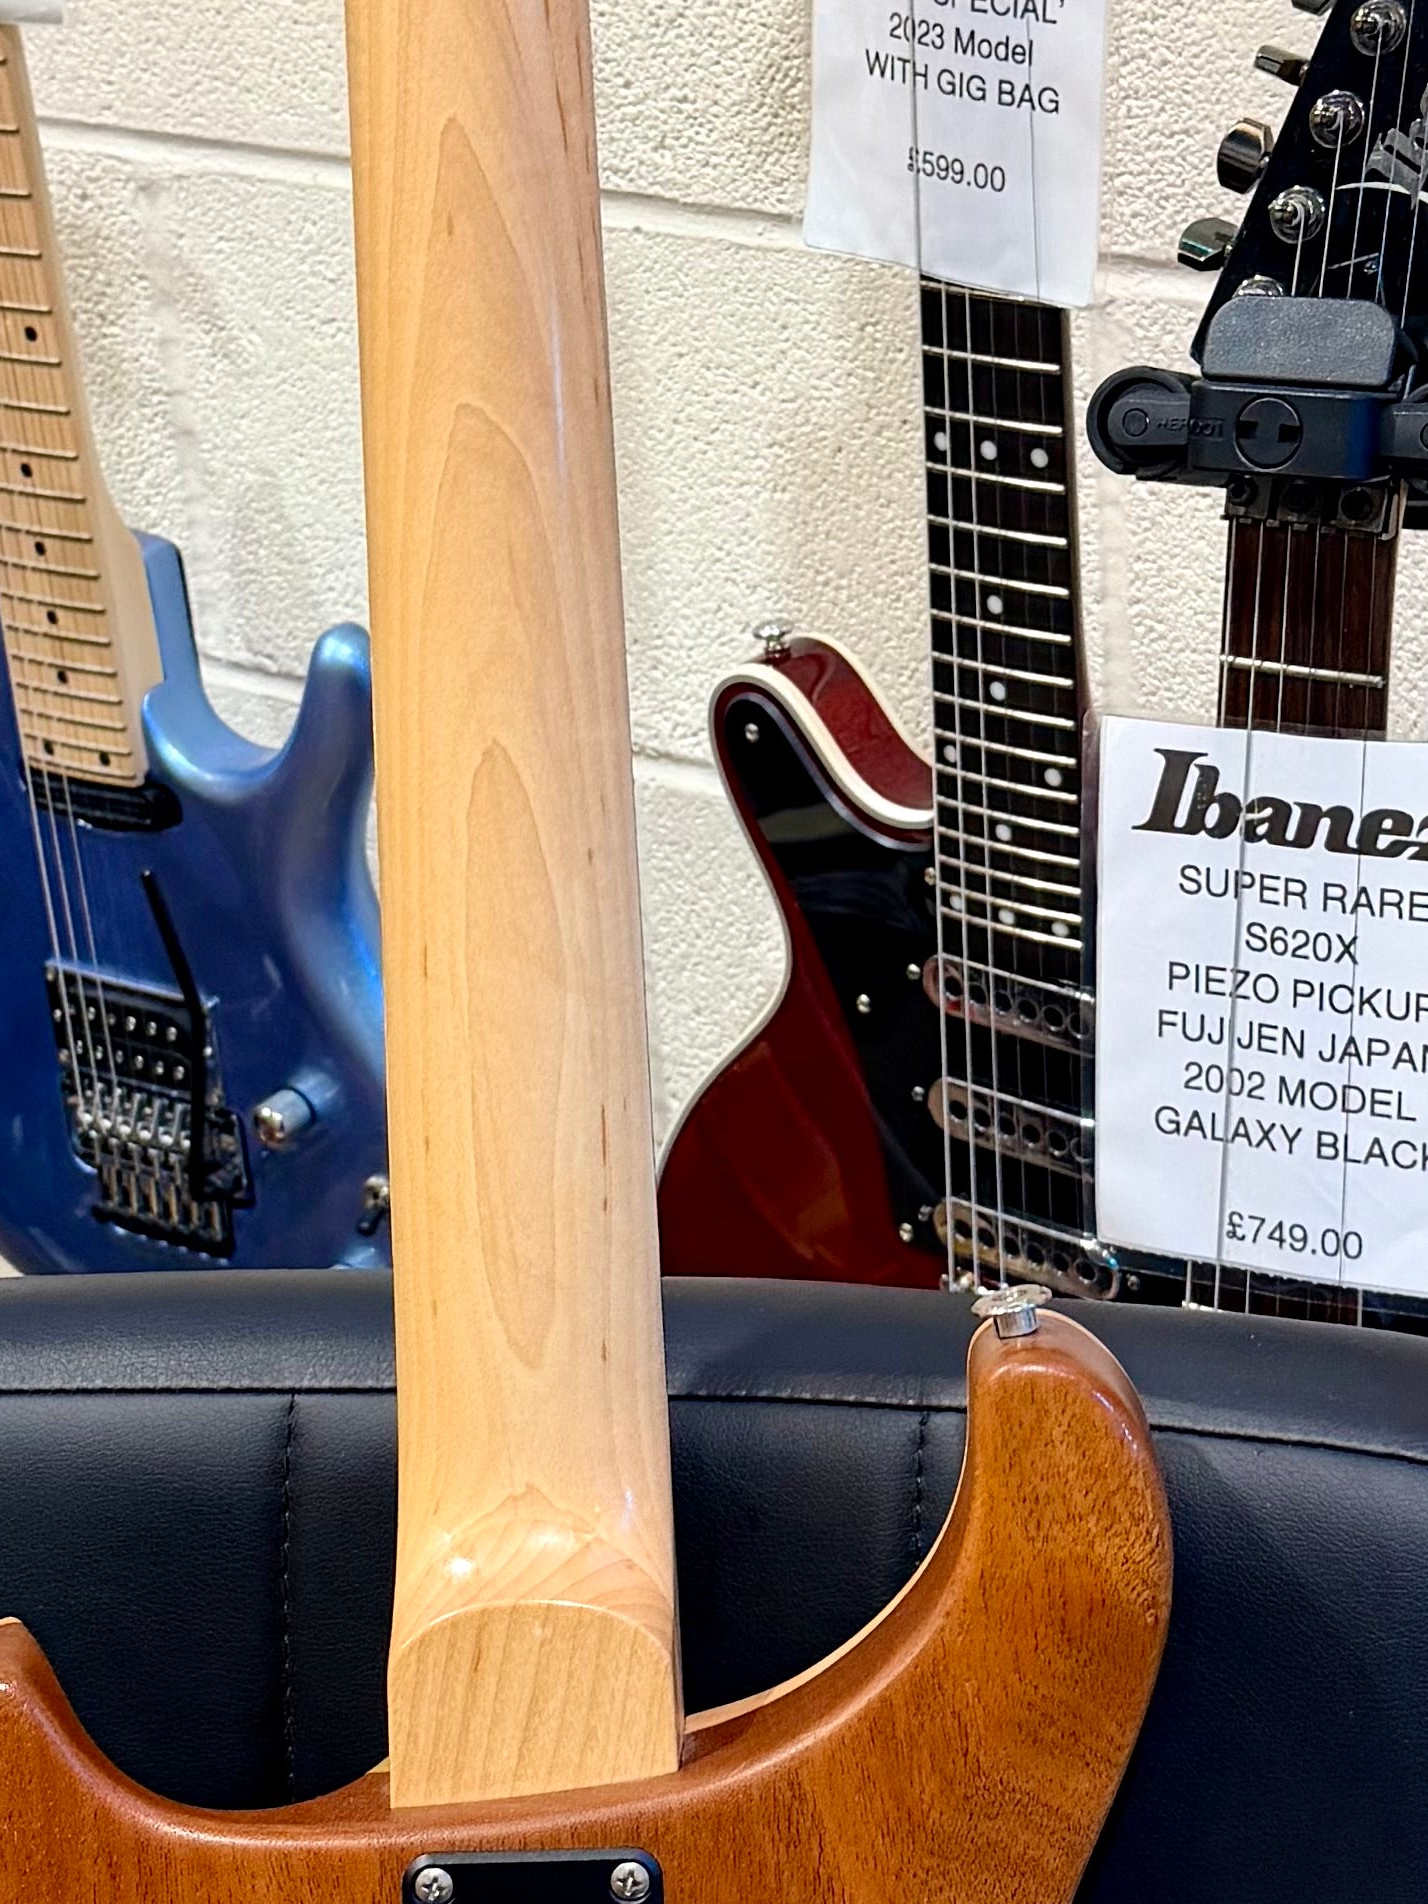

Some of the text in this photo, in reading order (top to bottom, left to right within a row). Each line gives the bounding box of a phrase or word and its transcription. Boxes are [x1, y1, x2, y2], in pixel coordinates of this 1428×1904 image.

[889, 12, 1034, 68] 2023 Model
[865, 47, 1061, 115] WITH GIG BAG
[907, 146, 1007, 193] £599.00
[1178, 864, 1309, 911] SUPER
[1245, 921, 1360, 966] S620X
[1168, 960, 1280, 1004] PIEZO
[1158, 1009, 1306, 1060] FUJJEN
[1183, 1061, 1418, 1122] 2002 MODEL
[1154, 1105, 1303, 1156] GALAXY
[1226, 1210, 1364, 1261] £749.00
